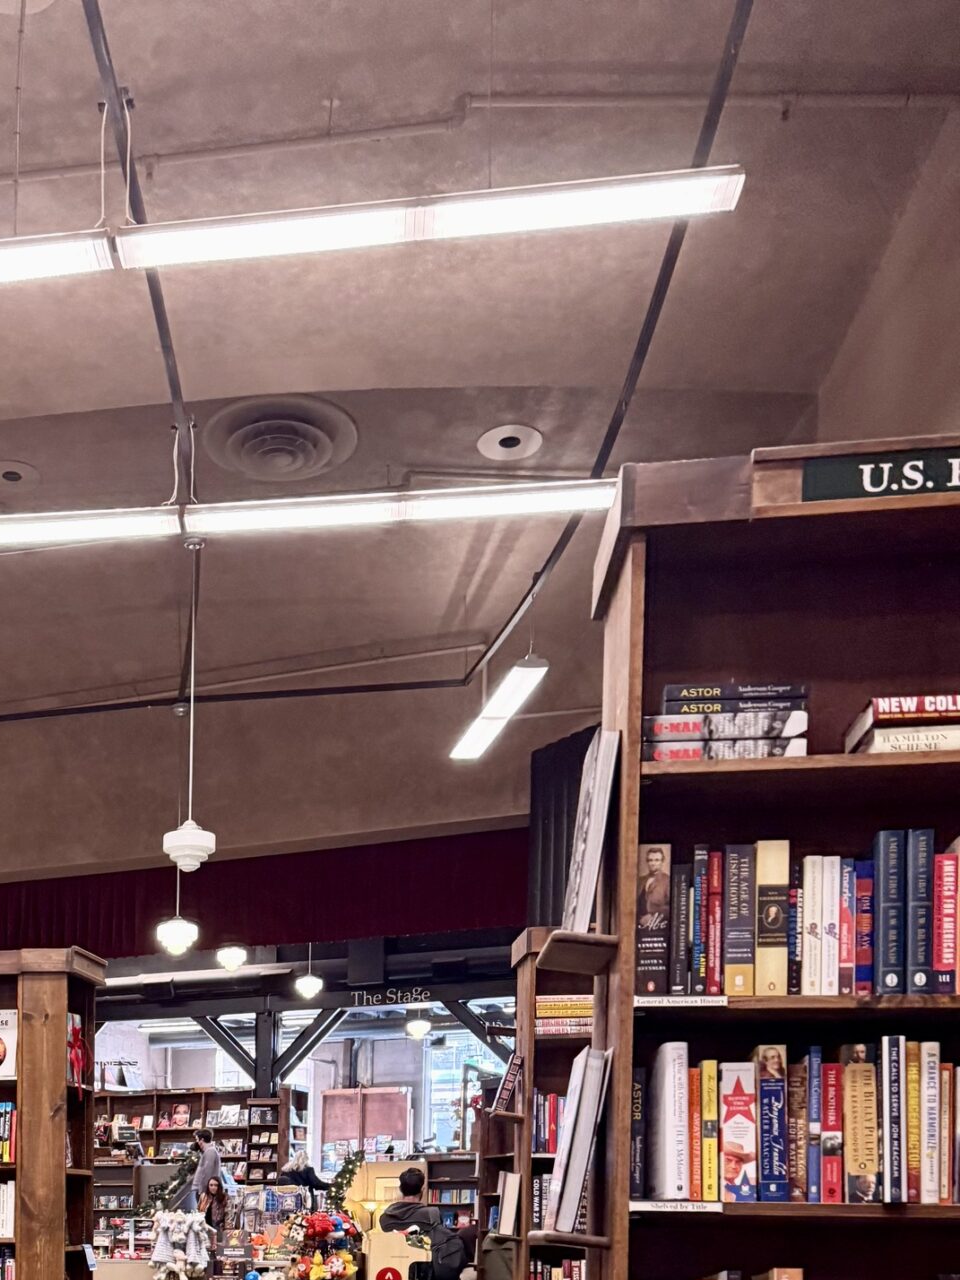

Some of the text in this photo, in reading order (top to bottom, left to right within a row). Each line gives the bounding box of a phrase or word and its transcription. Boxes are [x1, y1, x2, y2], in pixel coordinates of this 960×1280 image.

[858, 460, 934, 493] U.S.
[681, 687, 721, 697] ASTOR
[878, 697, 916, 713] NEW
[729, 853, 738, 920] EISENHOWER
[740, 857, 749, 916] THE AGE OF
[842, 865, 853, 908] America
[943, 860, 955, 964] AMERICA FOR AMERICANS
[351, 987, 430, 1006] The Stage
[891, 1083, 898, 1092] TO
[927, 1060, 937, 1090] CHANCE
[632, 1082, 641, 1120] ASTOR
[828, 1070, 837, 1126] THE BROTHERS
[927, 1094, 937, 1104] TO
[927, 1106, 937, 1150] HARMONIZE
[762, 1134, 770, 1175] ISAACSON
